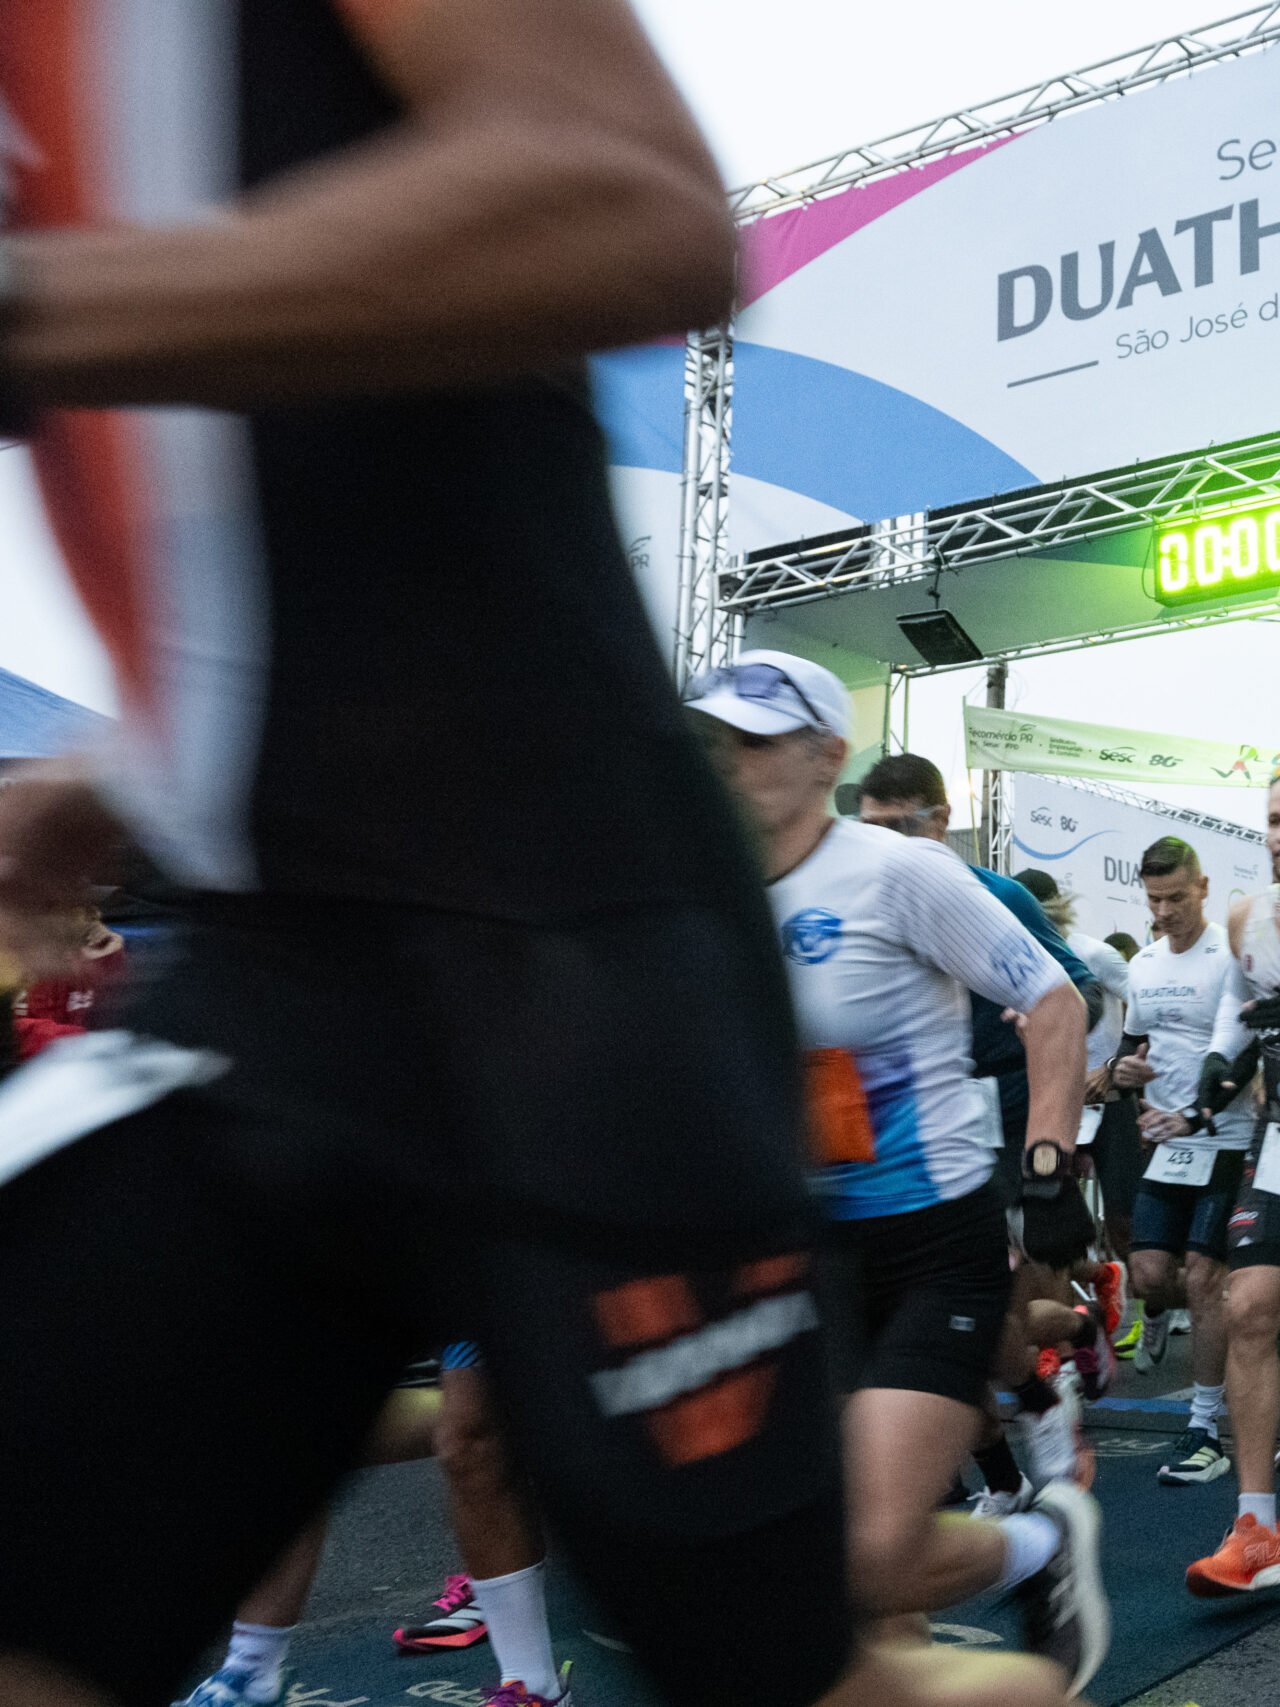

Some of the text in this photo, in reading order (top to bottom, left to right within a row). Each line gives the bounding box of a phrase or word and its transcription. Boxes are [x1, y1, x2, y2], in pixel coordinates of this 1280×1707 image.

[1116, 328, 1169, 359] São
[1180, 302, 1248, 343] José
[1099, 748, 1136, 763] Sesc
[1030, 810, 1052, 827] Sesc
[1104, 856, 1144, 888] DUA
